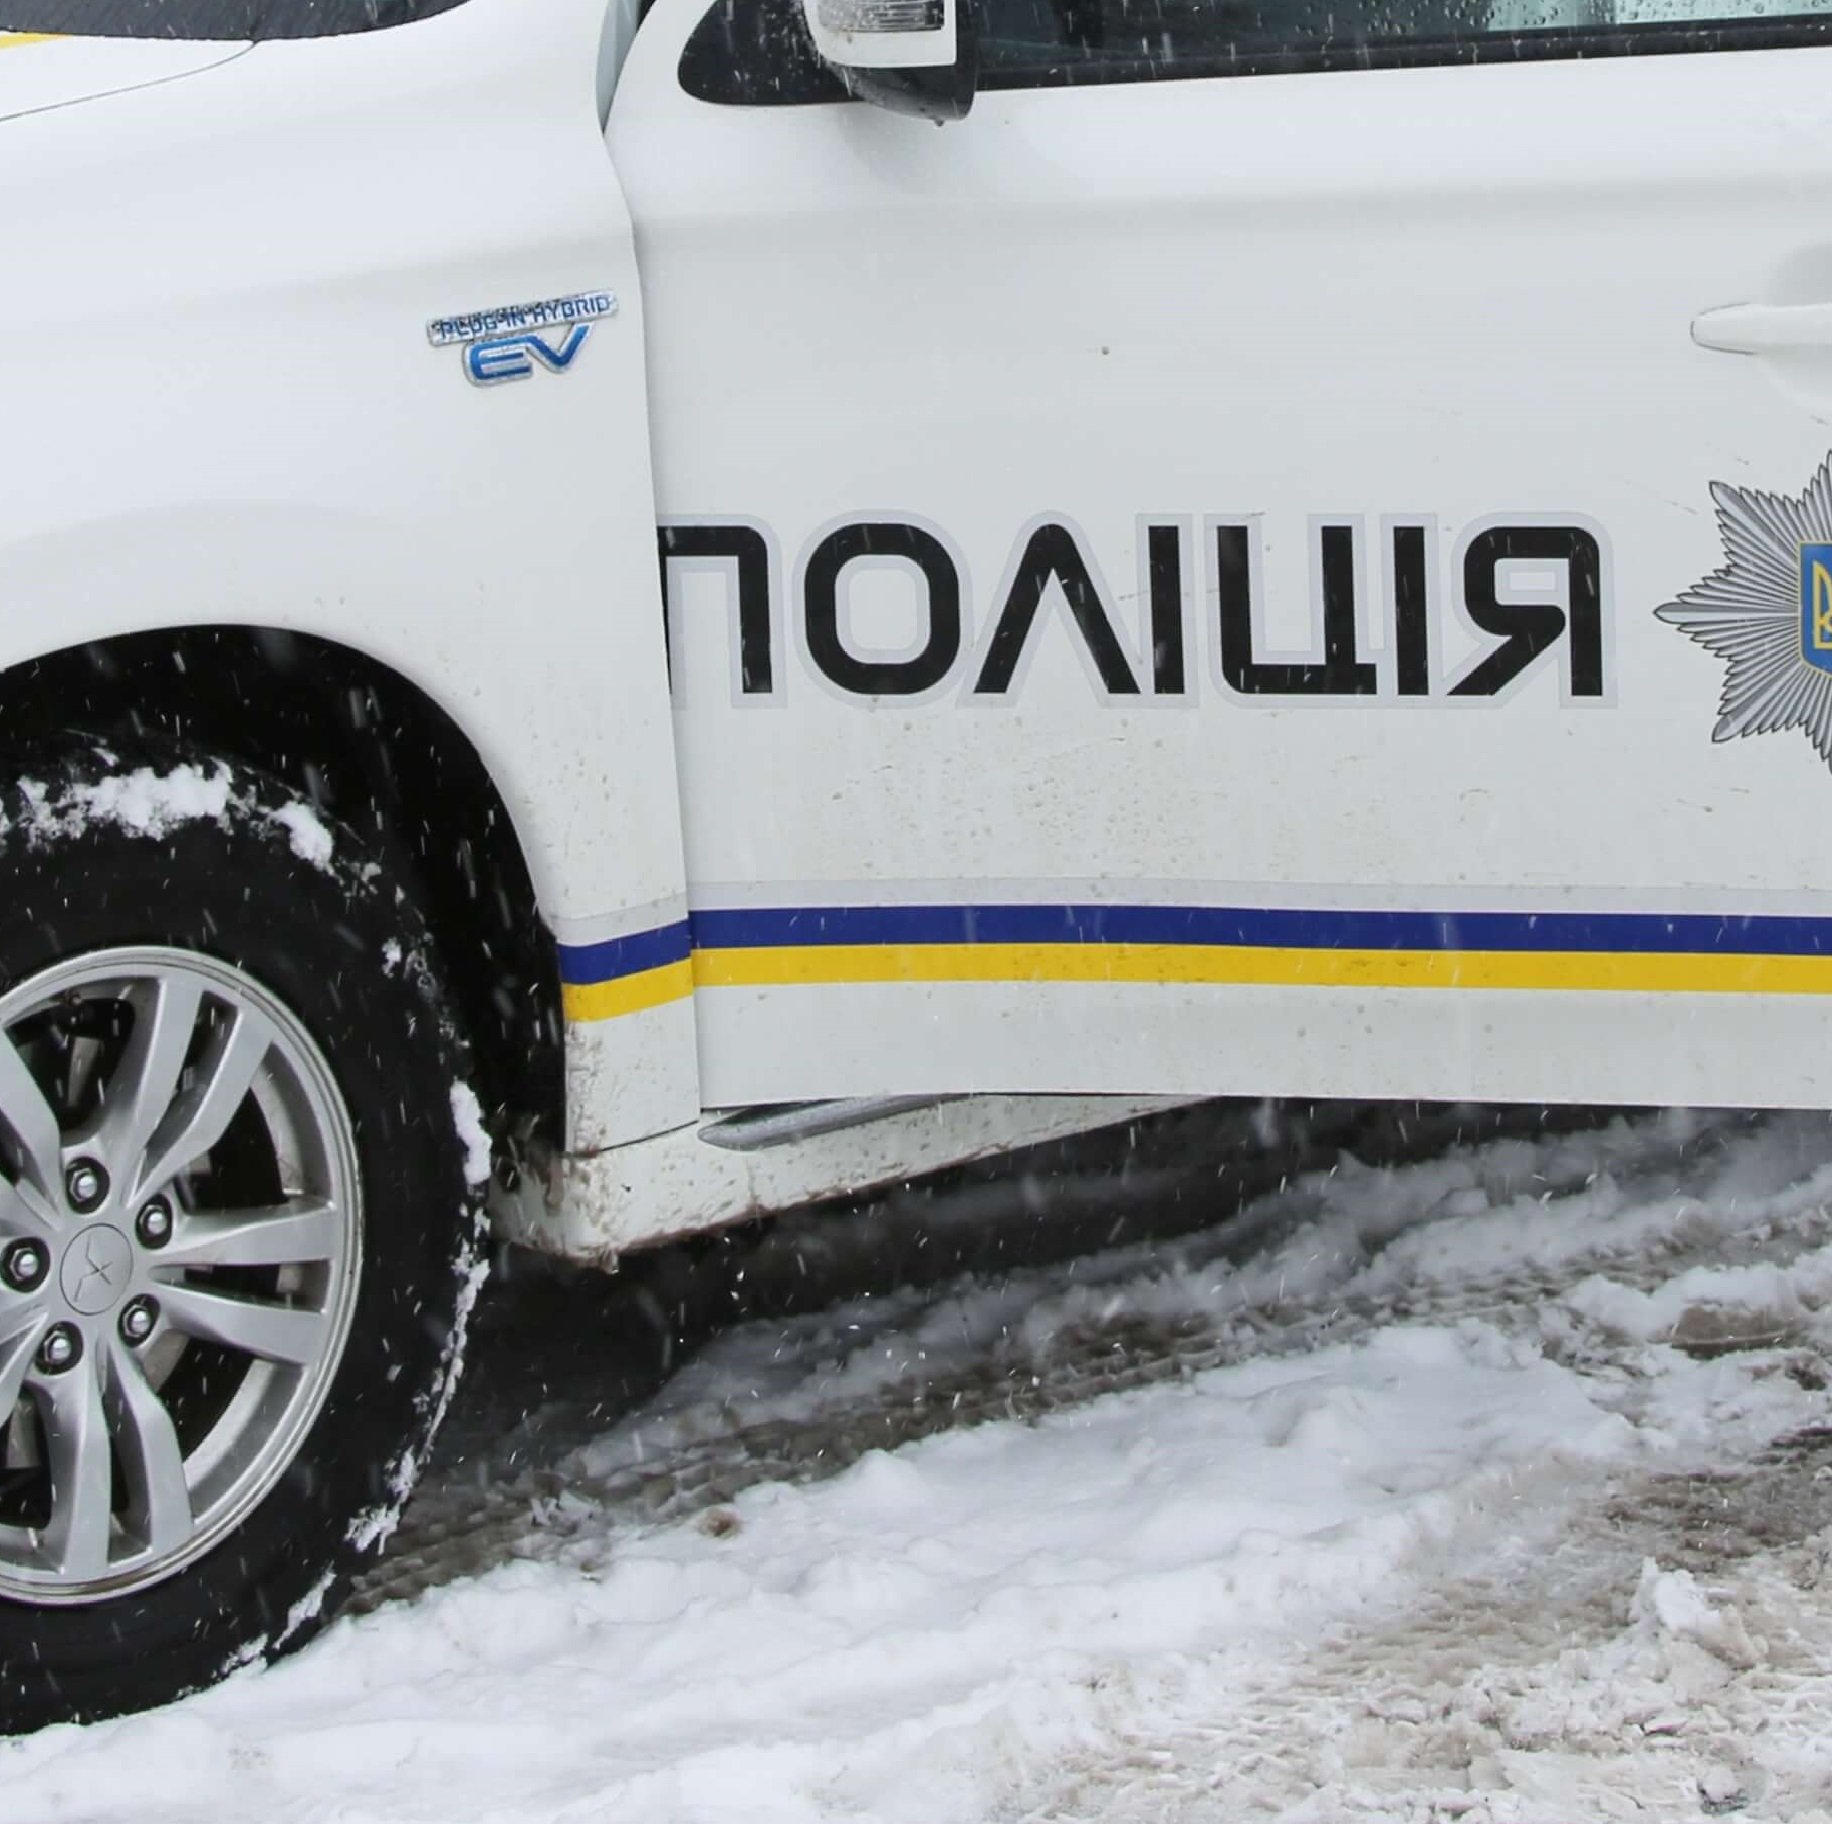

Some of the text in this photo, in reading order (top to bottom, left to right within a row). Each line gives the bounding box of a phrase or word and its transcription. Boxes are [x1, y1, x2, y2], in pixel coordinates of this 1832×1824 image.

[532, 294, 611, 325] HYBRID
[468, 322, 592, 381] EV
[656, 523, 1604, 697] ПОЛІЦІЯ
